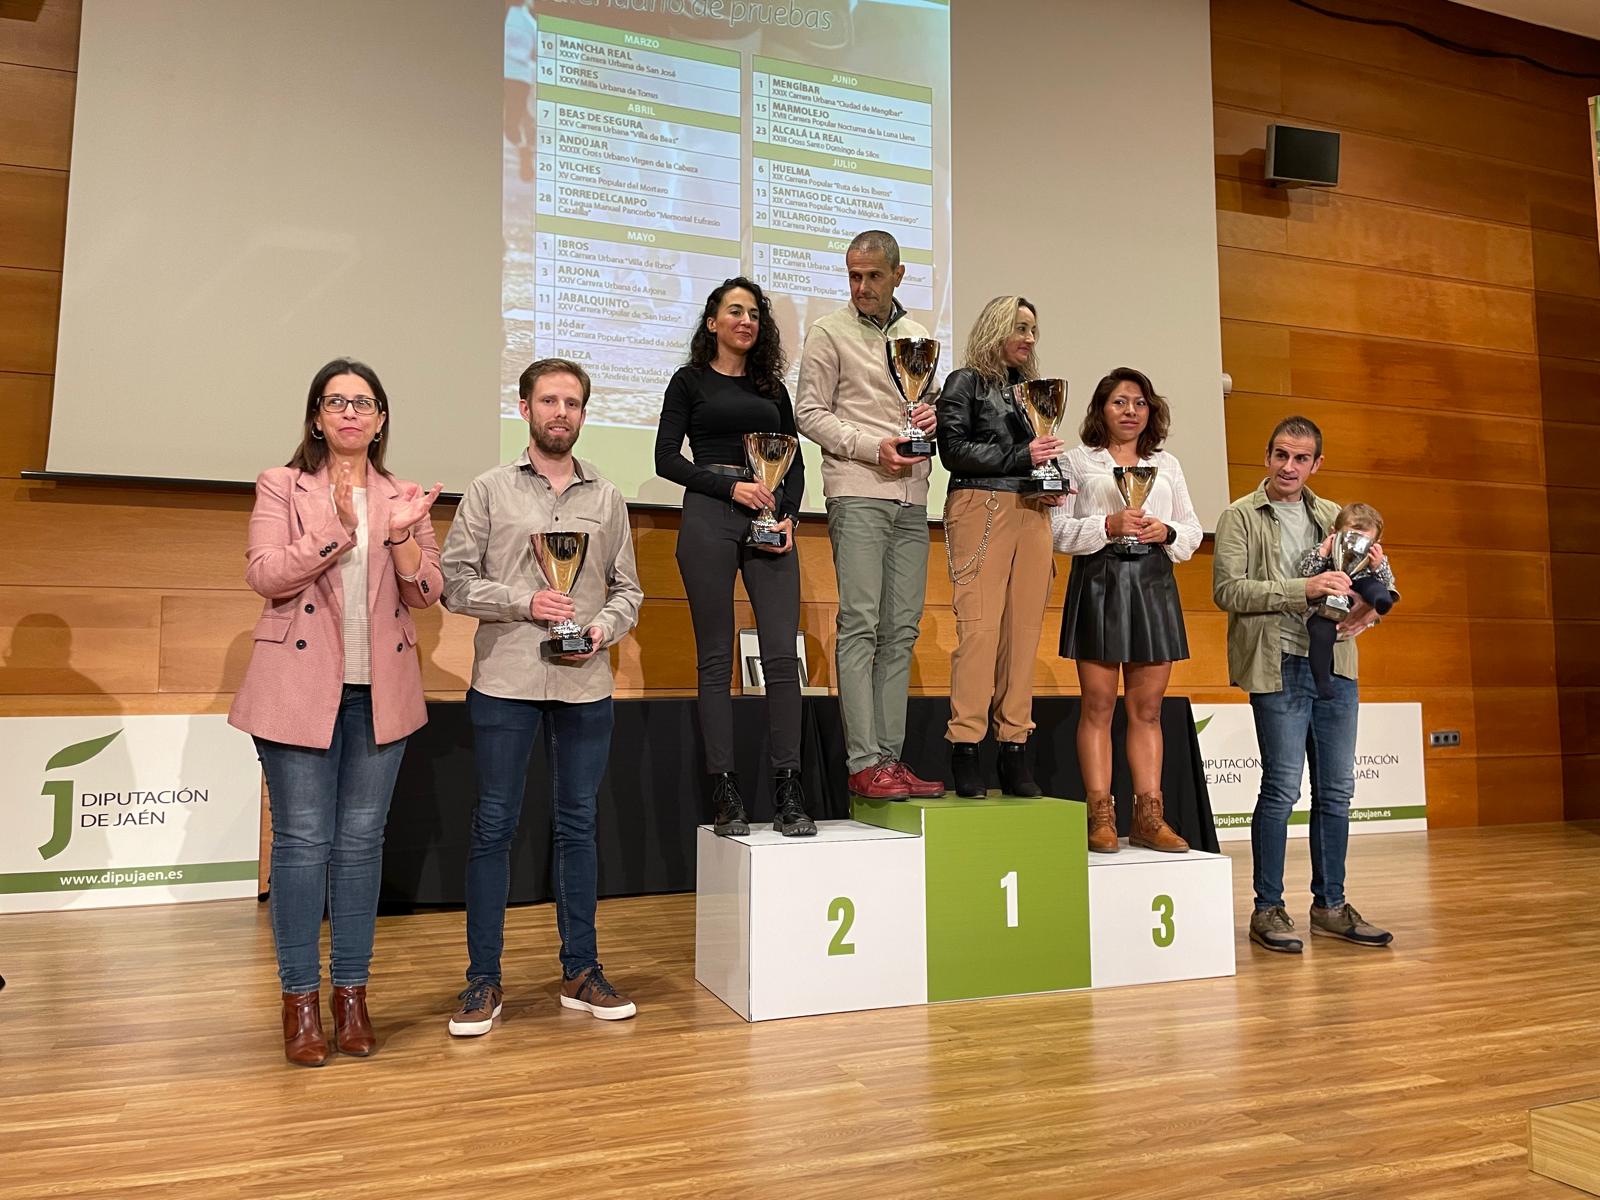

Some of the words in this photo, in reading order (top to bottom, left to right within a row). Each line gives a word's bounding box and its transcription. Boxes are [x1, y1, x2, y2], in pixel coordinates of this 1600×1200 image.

[730, 0, 832, 31] pruebas
[542, 41, 553, 50] 10
[624, 35, 659, 49] MARZO
[560, 40, 605, 56] MANCHA
[608, 49, 632, 60] REAL
[541, 67, 552, 76] 16
[560, 65, 598, 79] TORRES
[773, 79, 820, 94] MENGÍBAR
[832, 74, 857, 87] JUNIO
[544, 110, 548, 118] 7
[628, 104, 655, 116] ABRIL
[756, 104, 766, 112] 15
[773, 102, 829, 119] MARMOLEJO
[560, 109, 584, 120] BEAS
[588, 113, 601, 123] DE
[604, 116, 642, 130] SEGURA
[756, 127, 766, 135] 23
[773, 126, 808, 138] ALCALÁ
[810, 132, 820, 140] LA
[823, 134, 843, 144] REAL
[541, 136, 552, 145] 13
[559, 134, 608, 149] ANDÚJAR
[539, 163, 552, 172] 20
[559, 161, 600, 175] VILCHES
[773, 164, 810, 176] HUELMA
[833, 159, 856, 170] JULIO
[539, 194, 551, 202] 28
[559, 187, 647, 207] TORREDELCAMPO
[757, 189, 766, 197] 13
[773, 187, 819, 201] SANTIAGO
[821, 194, 832, 203] DE
[834, 196, 883, 210] CALATRAVA
[756, 211, 766, 220] 20
[773, 210, 836, 225] VILLARGORDO
[628, 231, 655, 242] MAYO
[543, 242, 547, 250] 1
[559, 240, 589, 251] IBROS
[773, 248, 811, 260] BEDMAR
[542, 268, 548, 276] 3
[558, 266, 599, 278] ARJONA
[773, 272, 810, 283] MARTOS
[539, 294, 550, 303] 11
[558, 292, 629, 308] JABALQUINTO
[539, 321, 550, 331] 18
[558, 319, 584, 330] Jódar
[558, 349, 591, 360] BAEZA
[1354, 753, 1399, 766] UTACIÓN
[1213, 771, 1242, 784] JAÉN
[1354, 767, 1380, 780] JAÉN
[81, 787, 209, 807] DIPUTACIÓN
[81, 813, 109, 828] DE
[113, 809, 165, 827] JAÉN
[60, 869, 183, 886] www.dipujaen.es
[1000, 871, 1019, 928] 1
[826, 896, 856, 957] 2
[1151, 894, 1176, 948] 3
